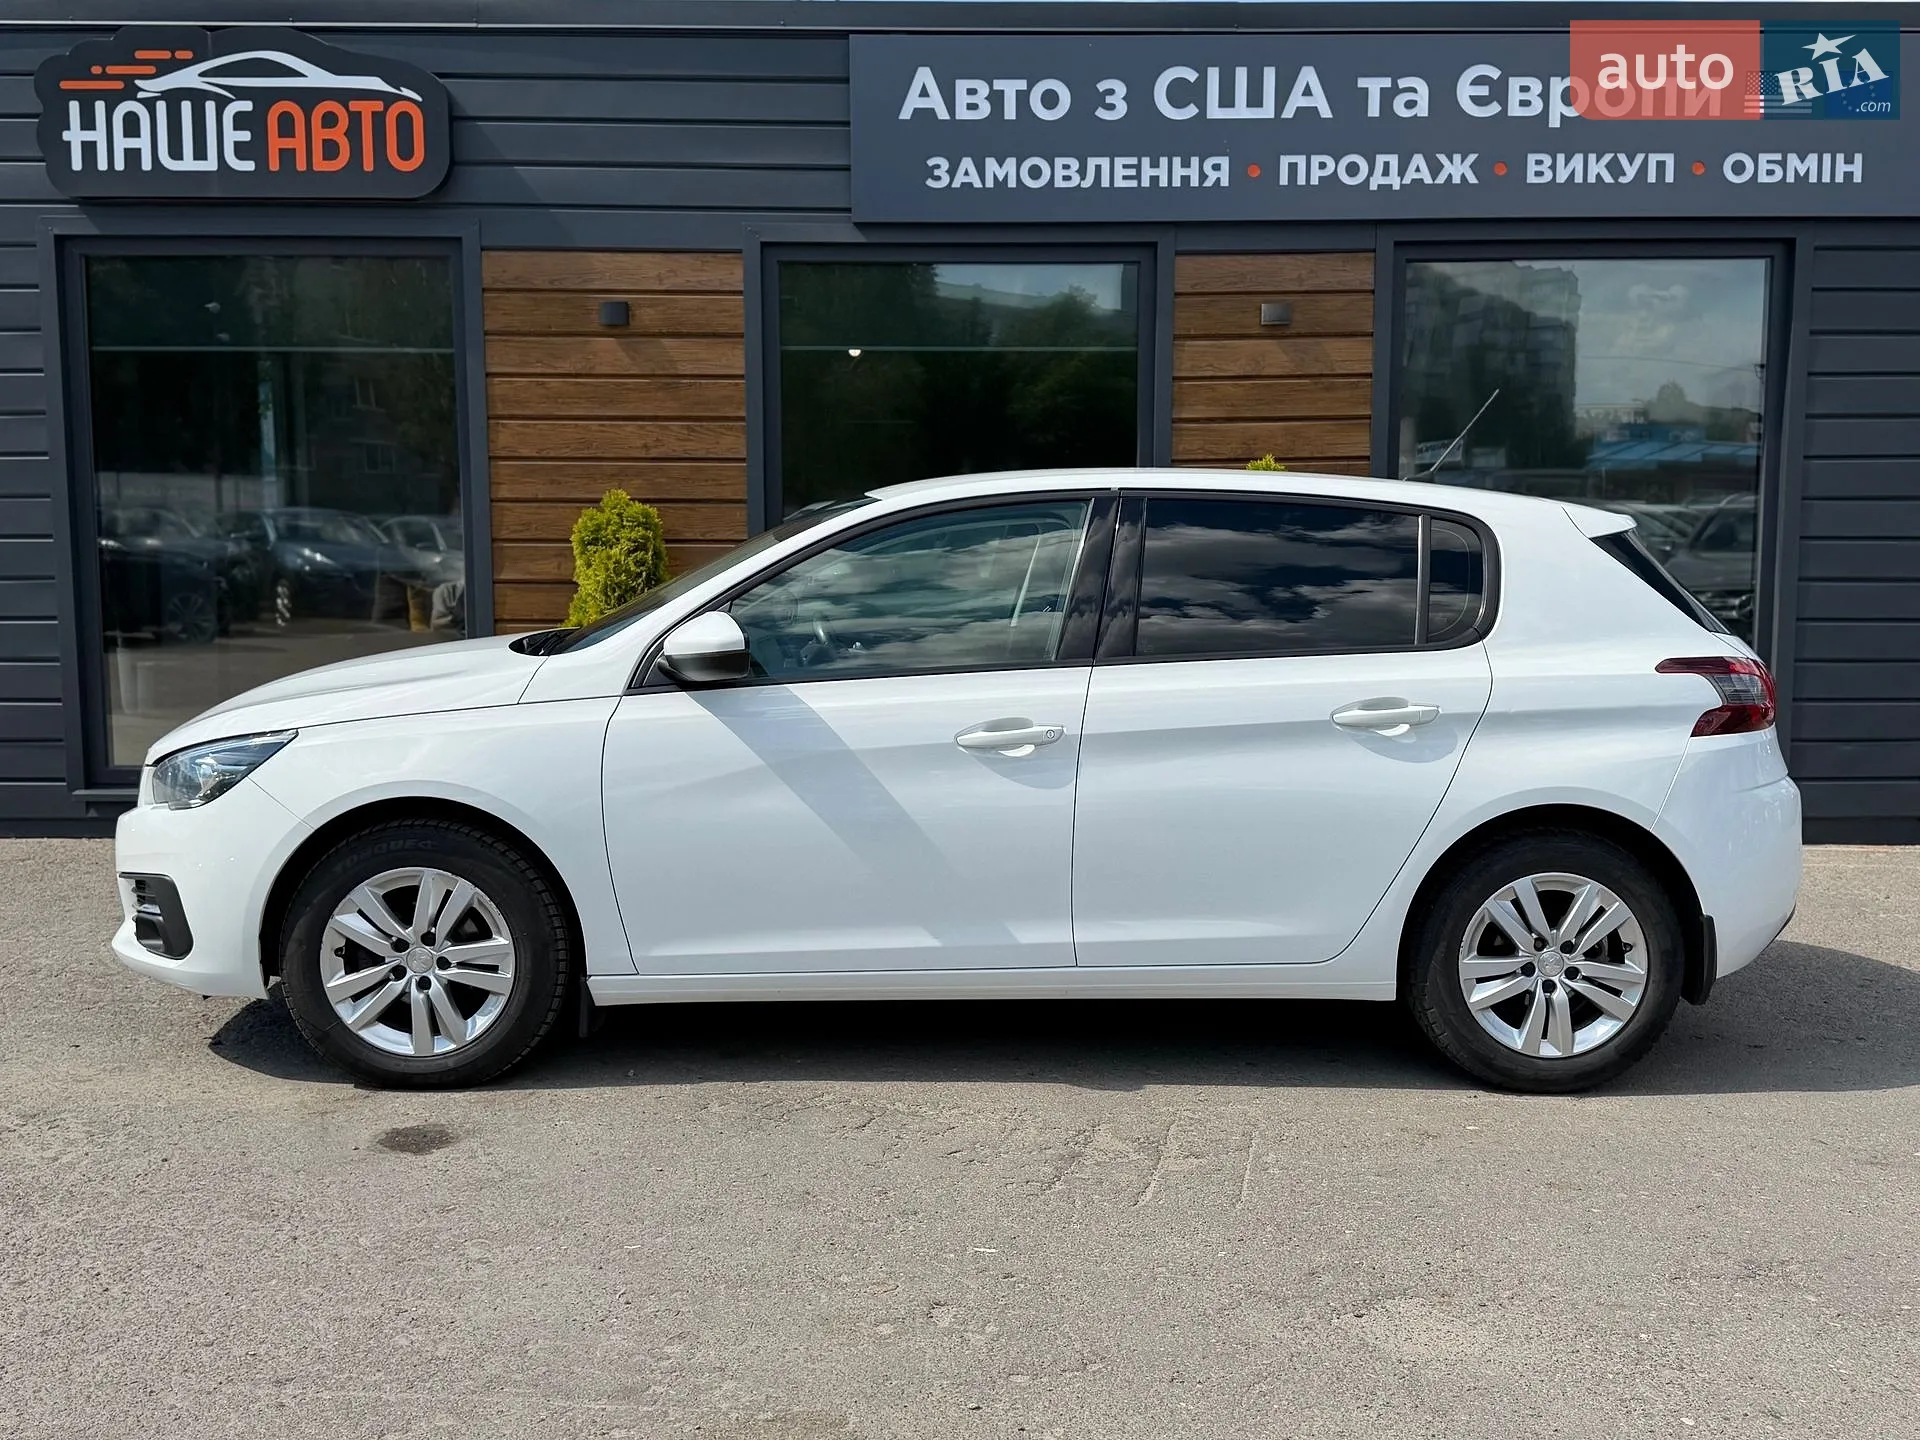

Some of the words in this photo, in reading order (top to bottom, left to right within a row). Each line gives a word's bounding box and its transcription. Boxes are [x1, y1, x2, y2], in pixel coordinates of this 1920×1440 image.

[899, 66, 1071, 120] Авто
[1095, 78, 1128, 120] з
[1153, 66, 1333, 120] США
[1358, 77, 1429, 118] та
[1456, 65, 1722, 127] Європи
[63, 101, 256, 171] НАШЕ
[267, 101, 425, 171] АВТО
[926, 156, 1230, 189] ЗАМОВЛЕННЯ
[1279, 154, 1479, 191] ПРОДАЖ
[1526, 153, 1675, 184] ВИКУП
[1722, 153, 1863, 184] ОБМІН
